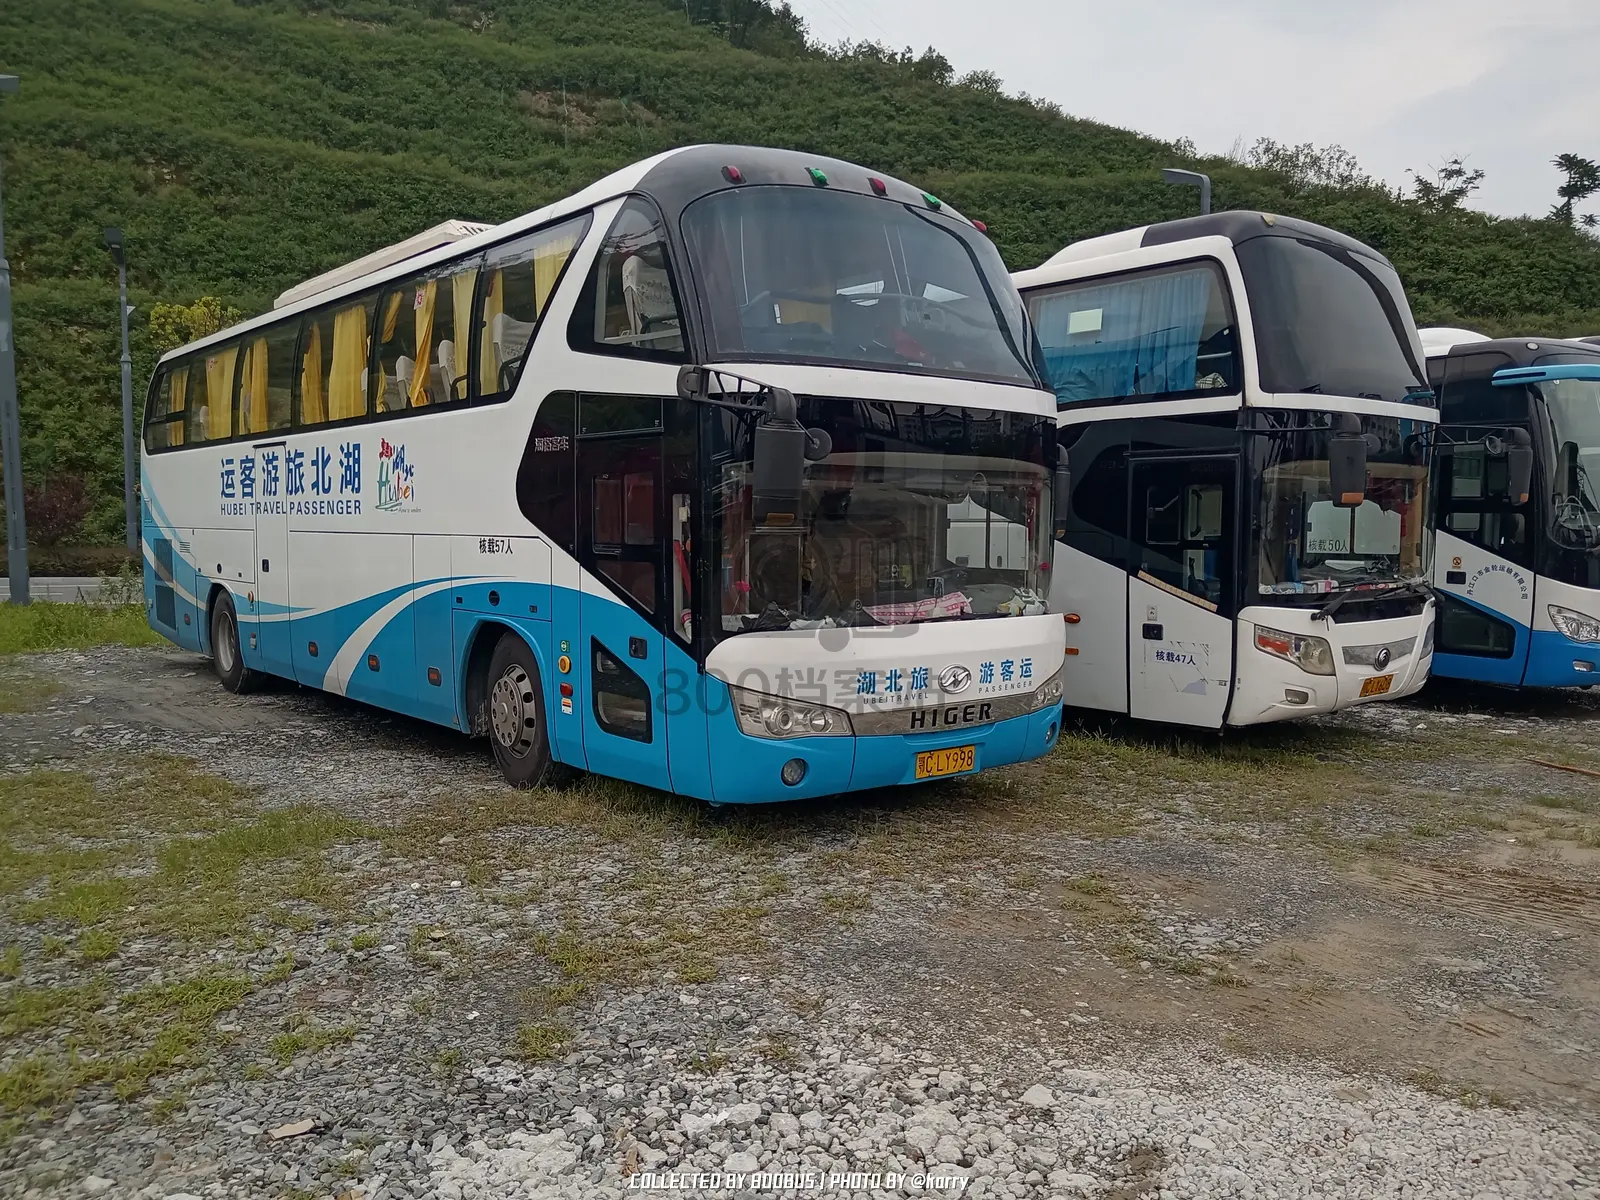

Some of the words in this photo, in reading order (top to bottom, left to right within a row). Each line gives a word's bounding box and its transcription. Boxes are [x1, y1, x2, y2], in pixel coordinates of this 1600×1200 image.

[220, 503, 247, 515] HUBEI
[250, 501, 287, 515] TRAVEL
[289, 500, 361, 515] PASSENGER
[479, 538, 513, 554] 核载57人
[1308, 540, 1349, 552] 核载50人
[1156, 650, 1196, 665] 核载47人
[979, 681, 1032, 693] PASSENGER
[910, 702, 993, 729] HIGER
